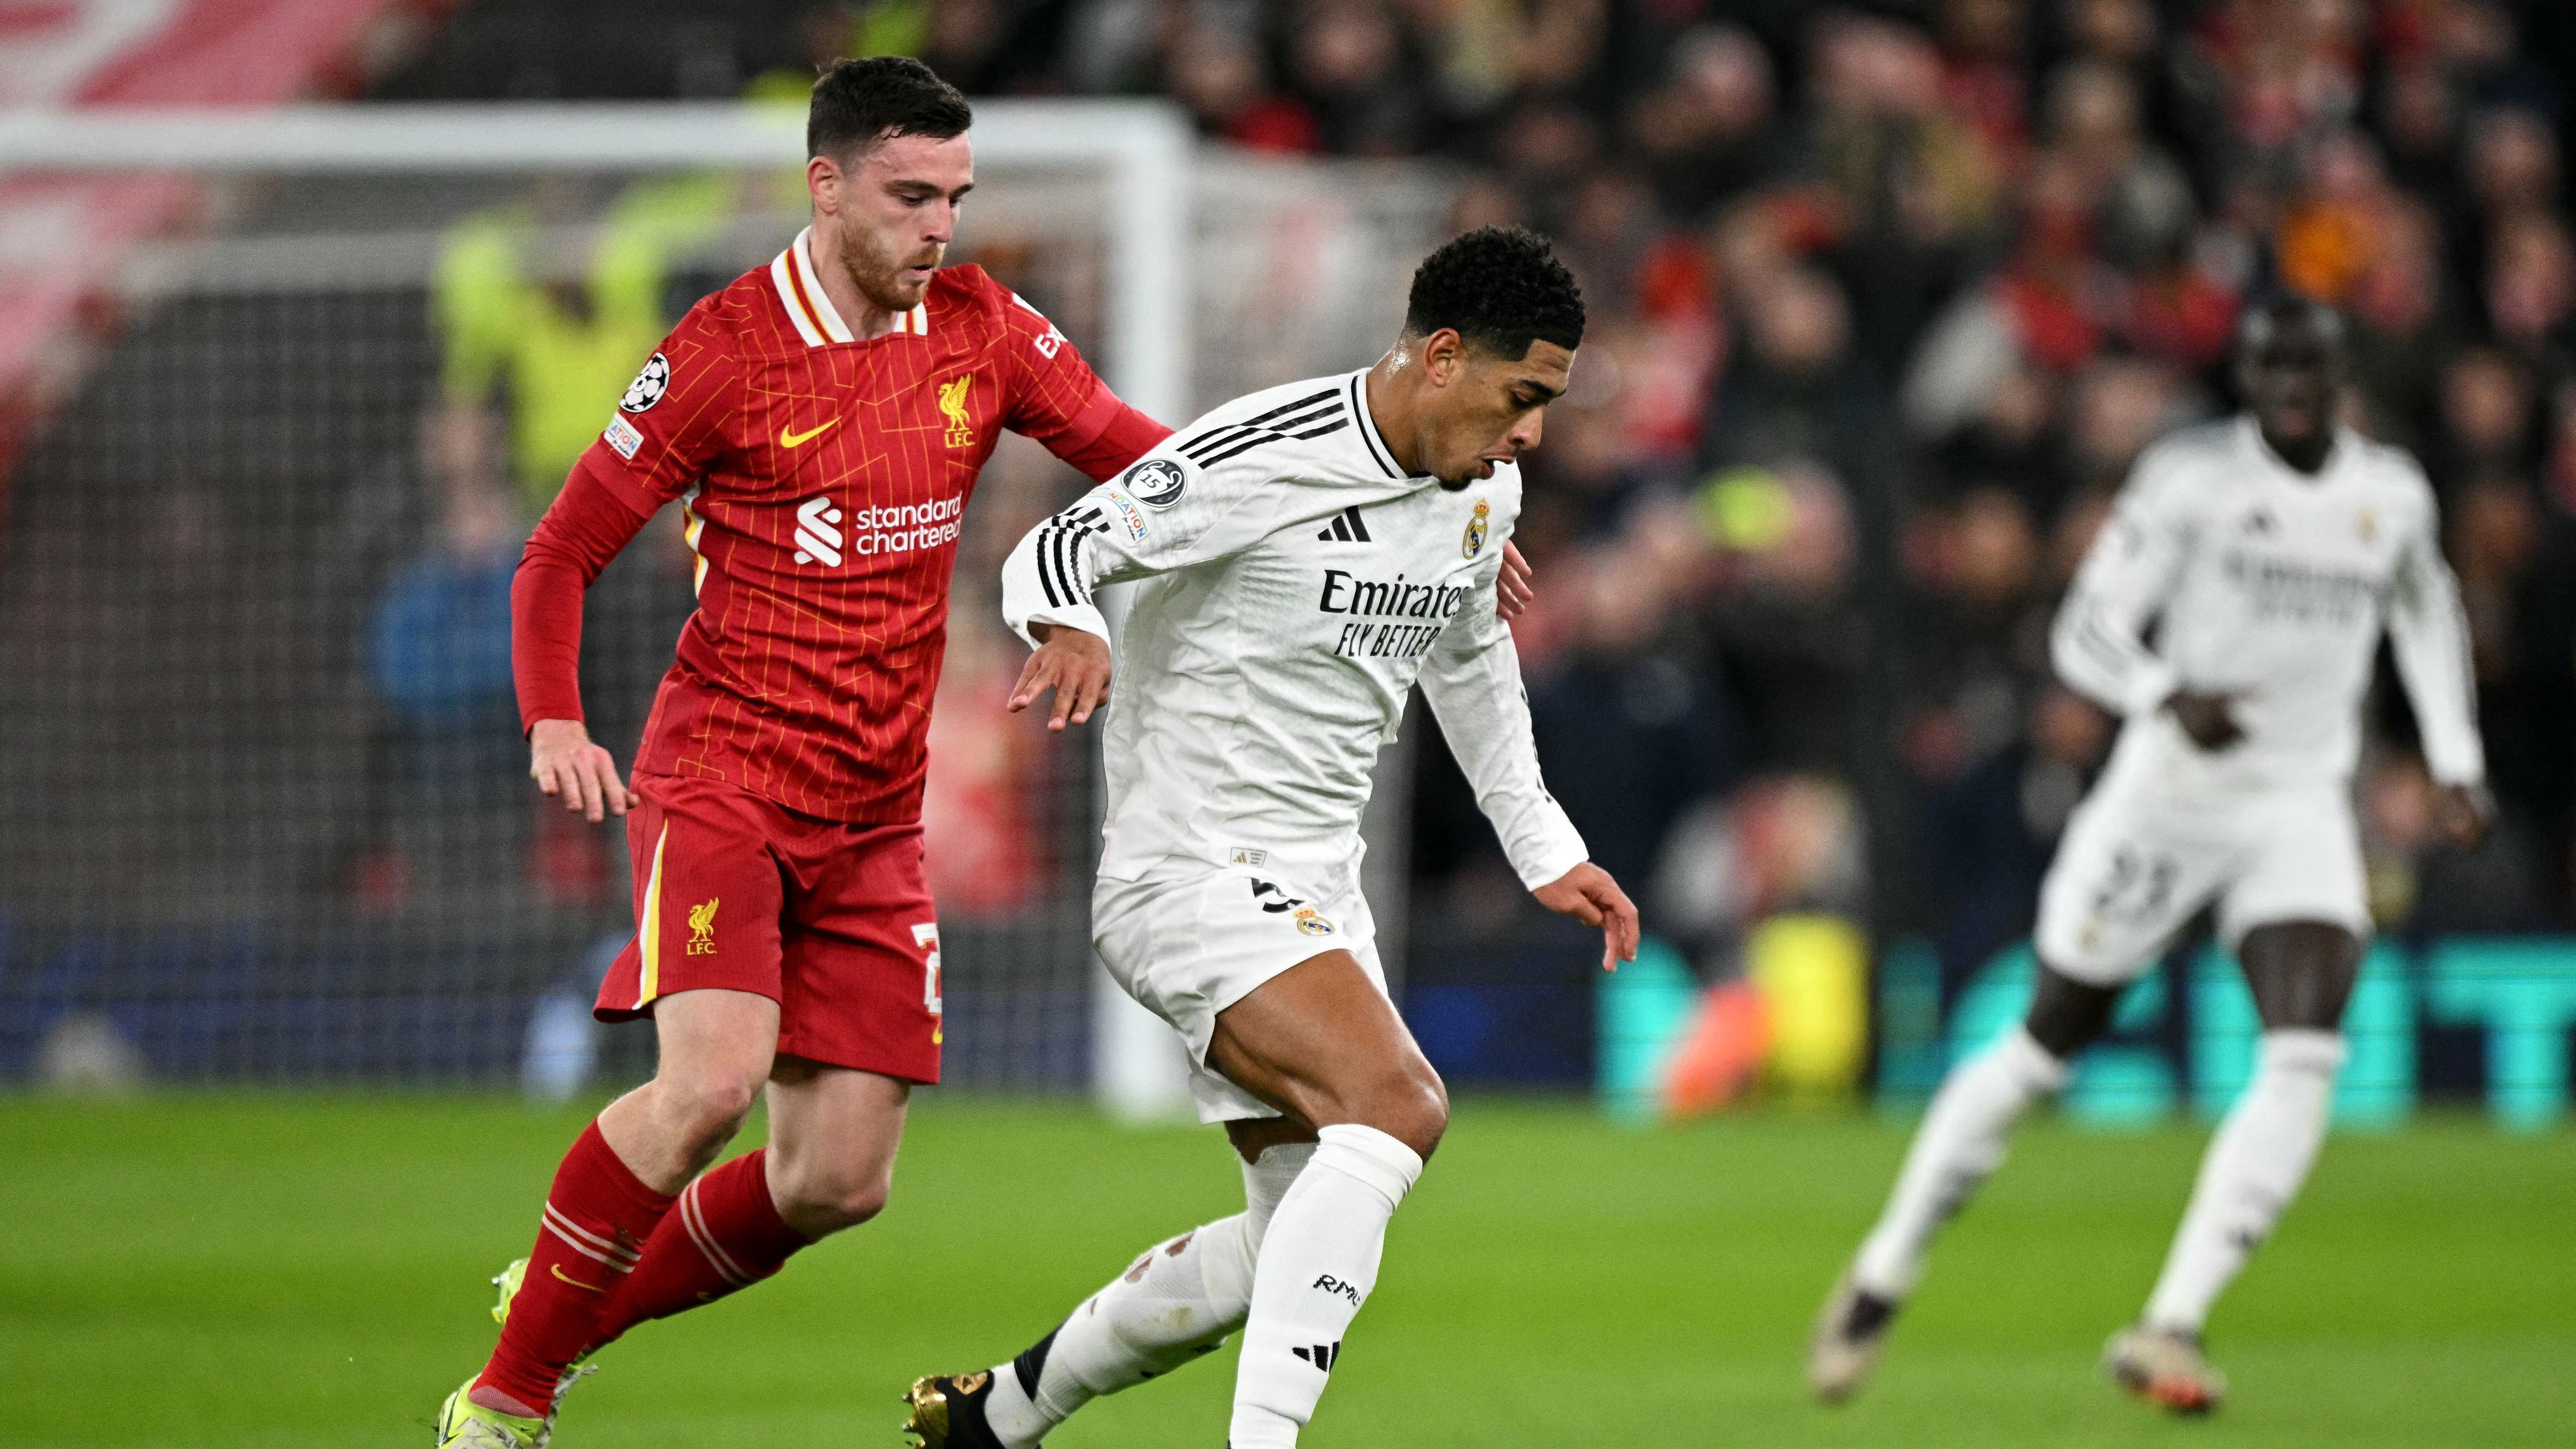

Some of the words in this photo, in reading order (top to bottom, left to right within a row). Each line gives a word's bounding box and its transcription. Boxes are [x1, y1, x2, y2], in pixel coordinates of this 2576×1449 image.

[1140, 474, 1161, 488] 15
[856, 490, 963, 530] standard
[856, 513, 963, 555] chartered
[1334, 623, 1375, 657] FLY
[1369, 624, 1442, 658] BETTER
